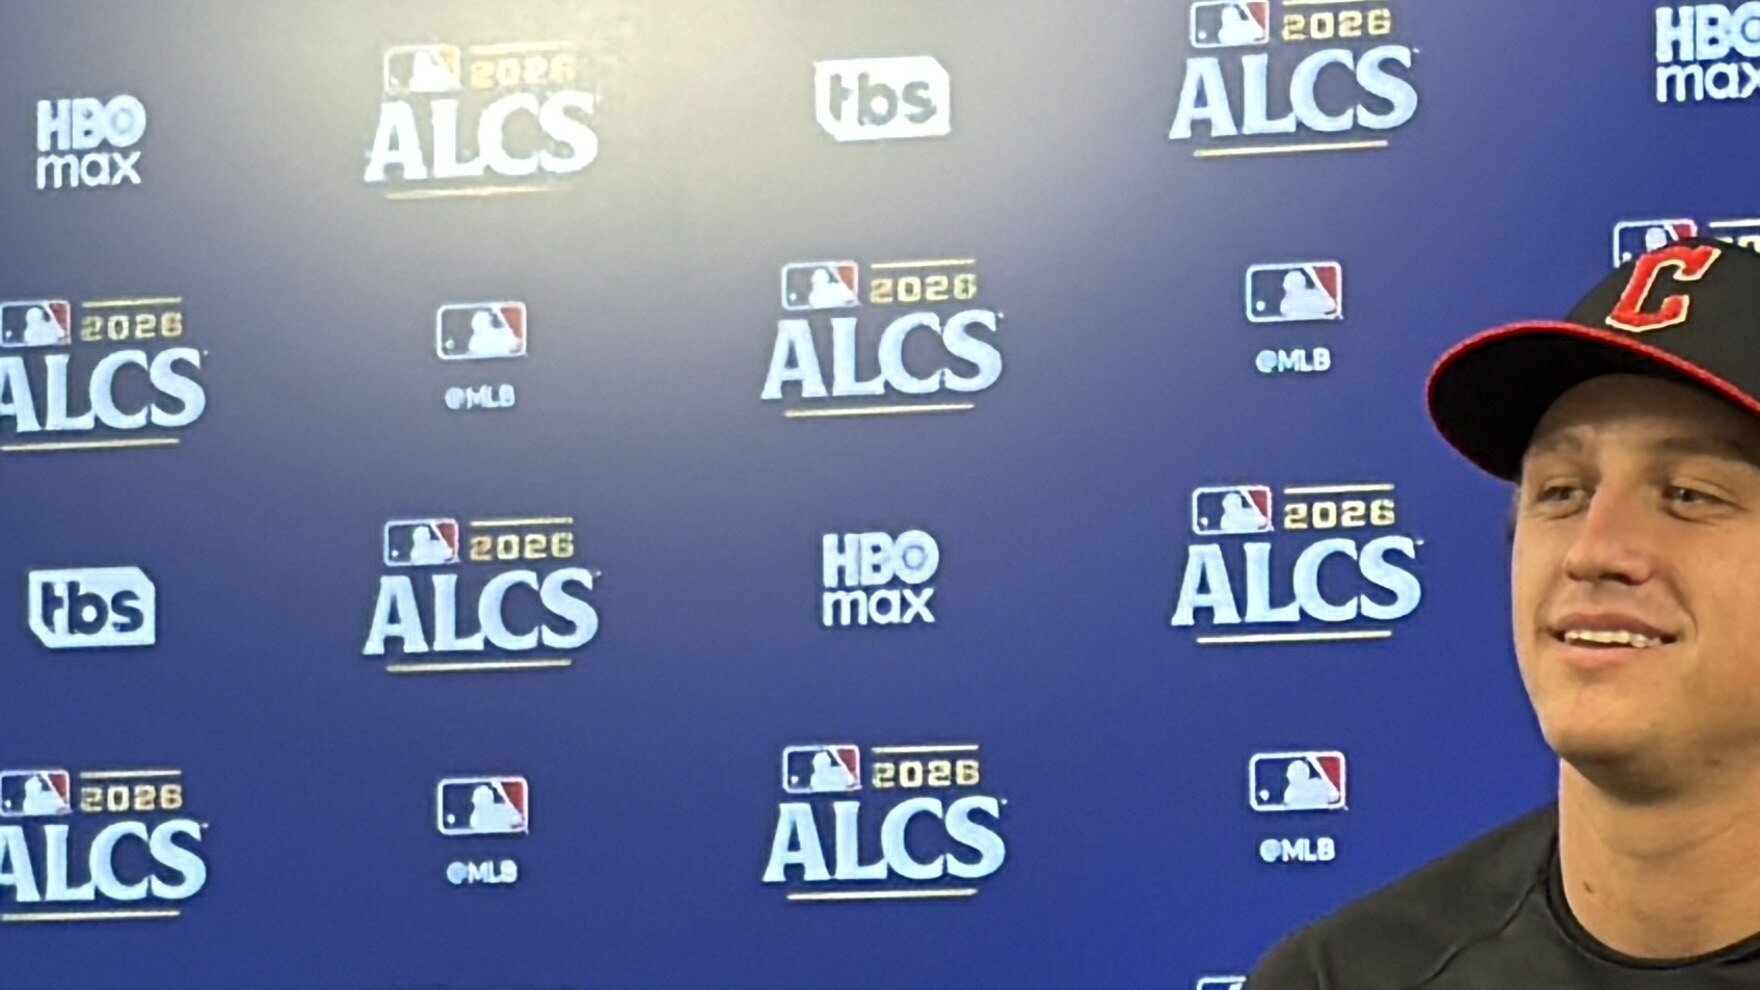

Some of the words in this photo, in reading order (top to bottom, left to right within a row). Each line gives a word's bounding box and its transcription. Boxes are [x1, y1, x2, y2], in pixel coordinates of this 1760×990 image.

[1281, 9, 1392, 39] 2026
[829, 74, 937, 127] tbs
[1169, 46, 1418, 139] ALCS
[37, 95, 147, 151] HBO
[364, 90, 599, 184] ALCS
[37, 150, 141, 189] max
[869, 274, 977, 304] 2026
[1605, 244, 1722, 333] C
[81, 311, 183, 341] 2026
[761, 311, 1002, 399] ALCS
[1256, 349, 1331, 373] @MLB
[446, 385, 516, 410] @MLB
[1284, 500, 1395, 531] 2026
[470, 532, 575, 561] 2026
[822, 530, 939, 589] HBO
[1171, 538, 1423, 626] ALCS
[42, 584, 145, 634] tbs
[363, 568, 600, 656] ALCS
[822, 588, 935, 627] max
[873, 760, 980, 788] 2026
[81, 785, 183, 812] 2026
[762, 796, 1006, 882] ALCS
[1260, 837, 1335, 862] @MLB
[447, 860, 518, 884] @MLB
